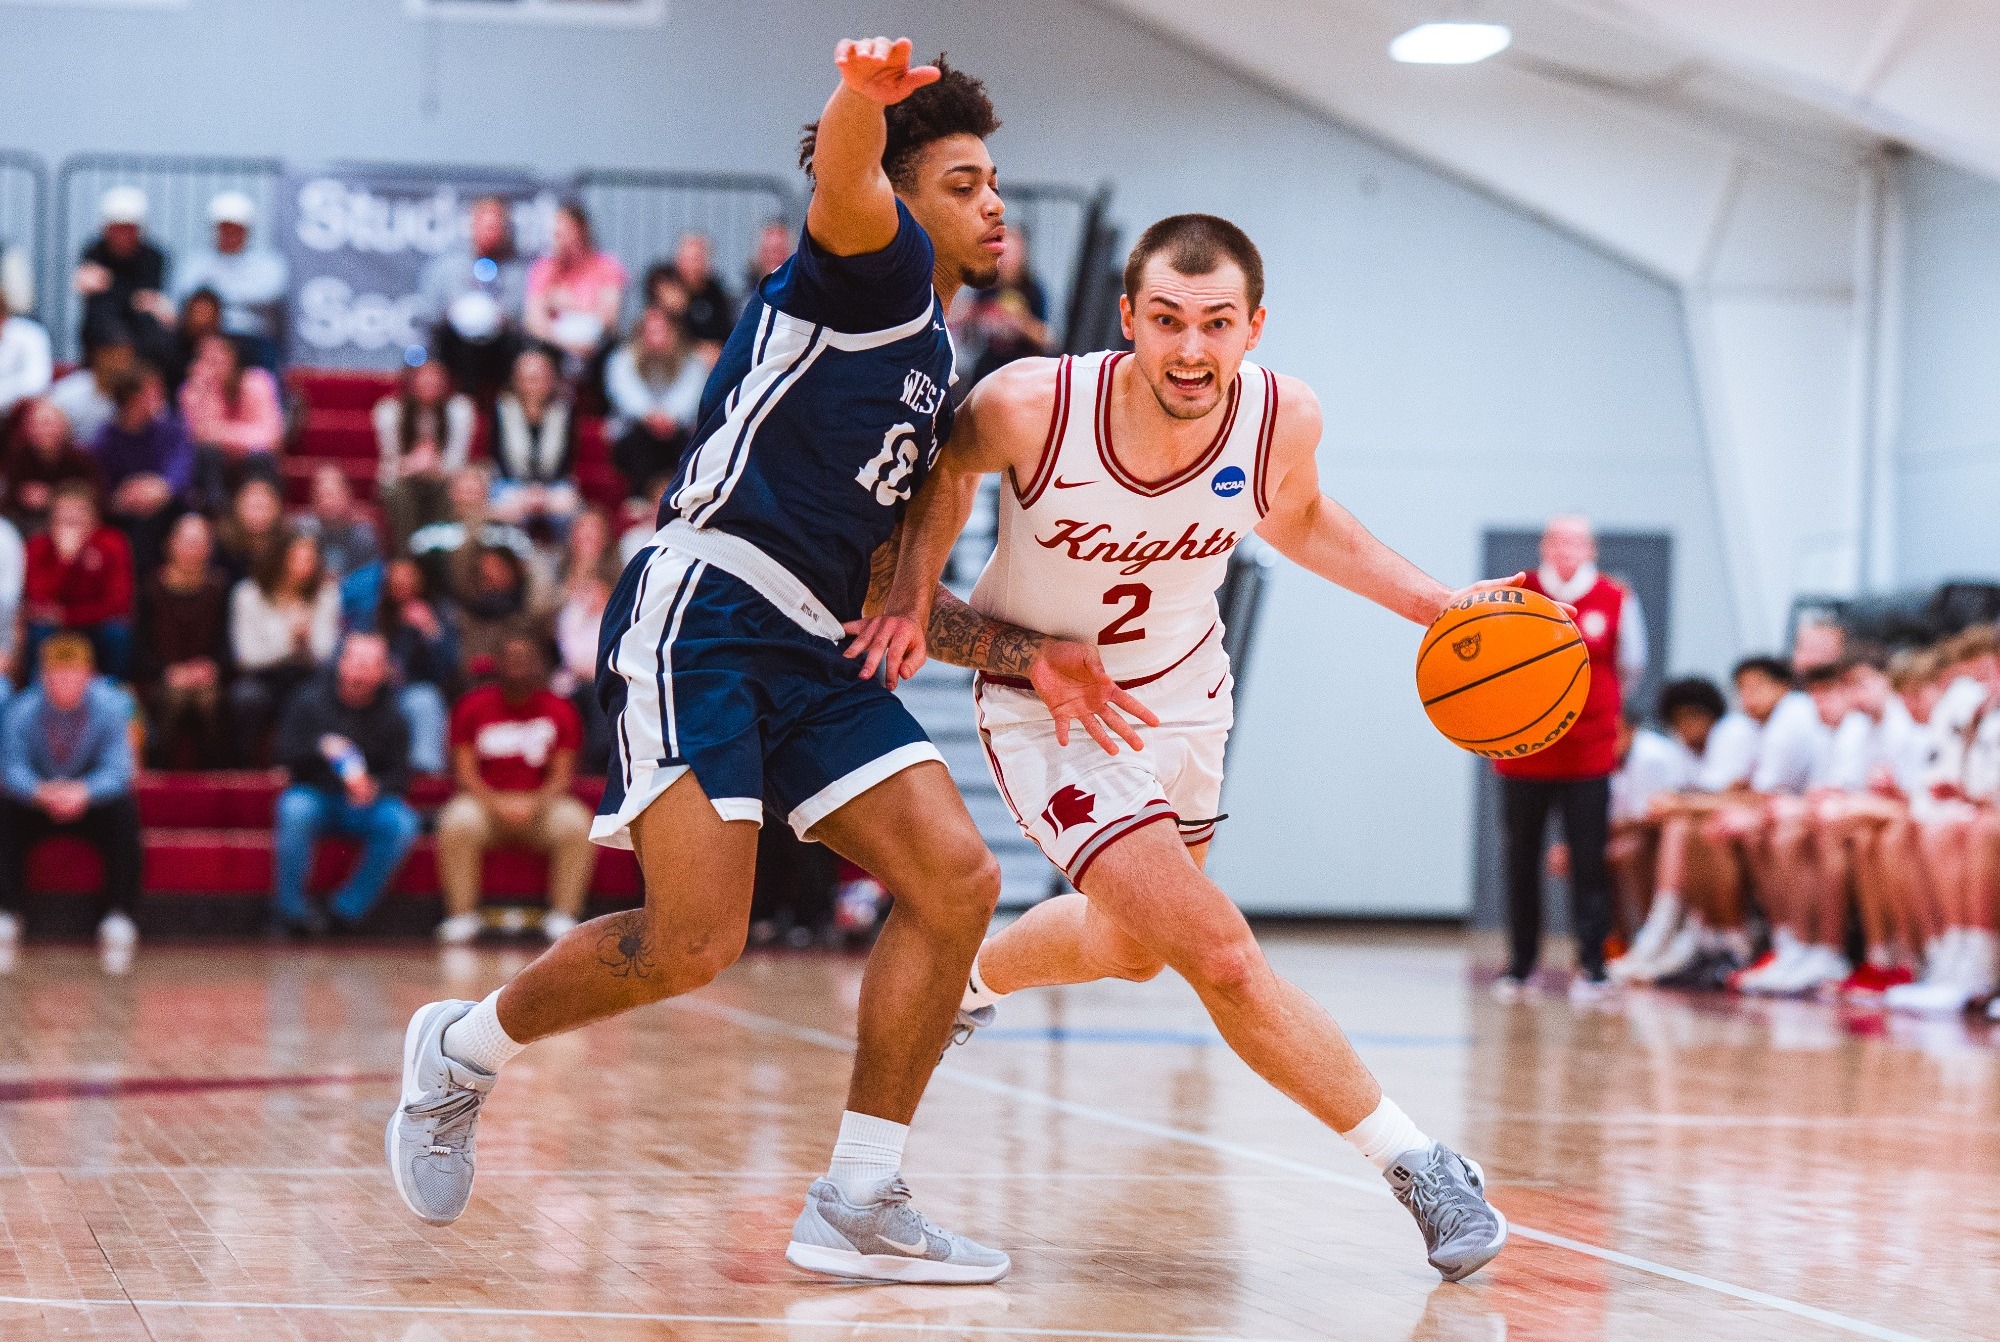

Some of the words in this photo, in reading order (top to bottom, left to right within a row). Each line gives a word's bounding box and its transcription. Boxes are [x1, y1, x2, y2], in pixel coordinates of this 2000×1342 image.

[1214, 480, 1245, 491] NCAA
[1034, 519, 1242, 576] Knights
[1097, 582, 1153, 646] 2
